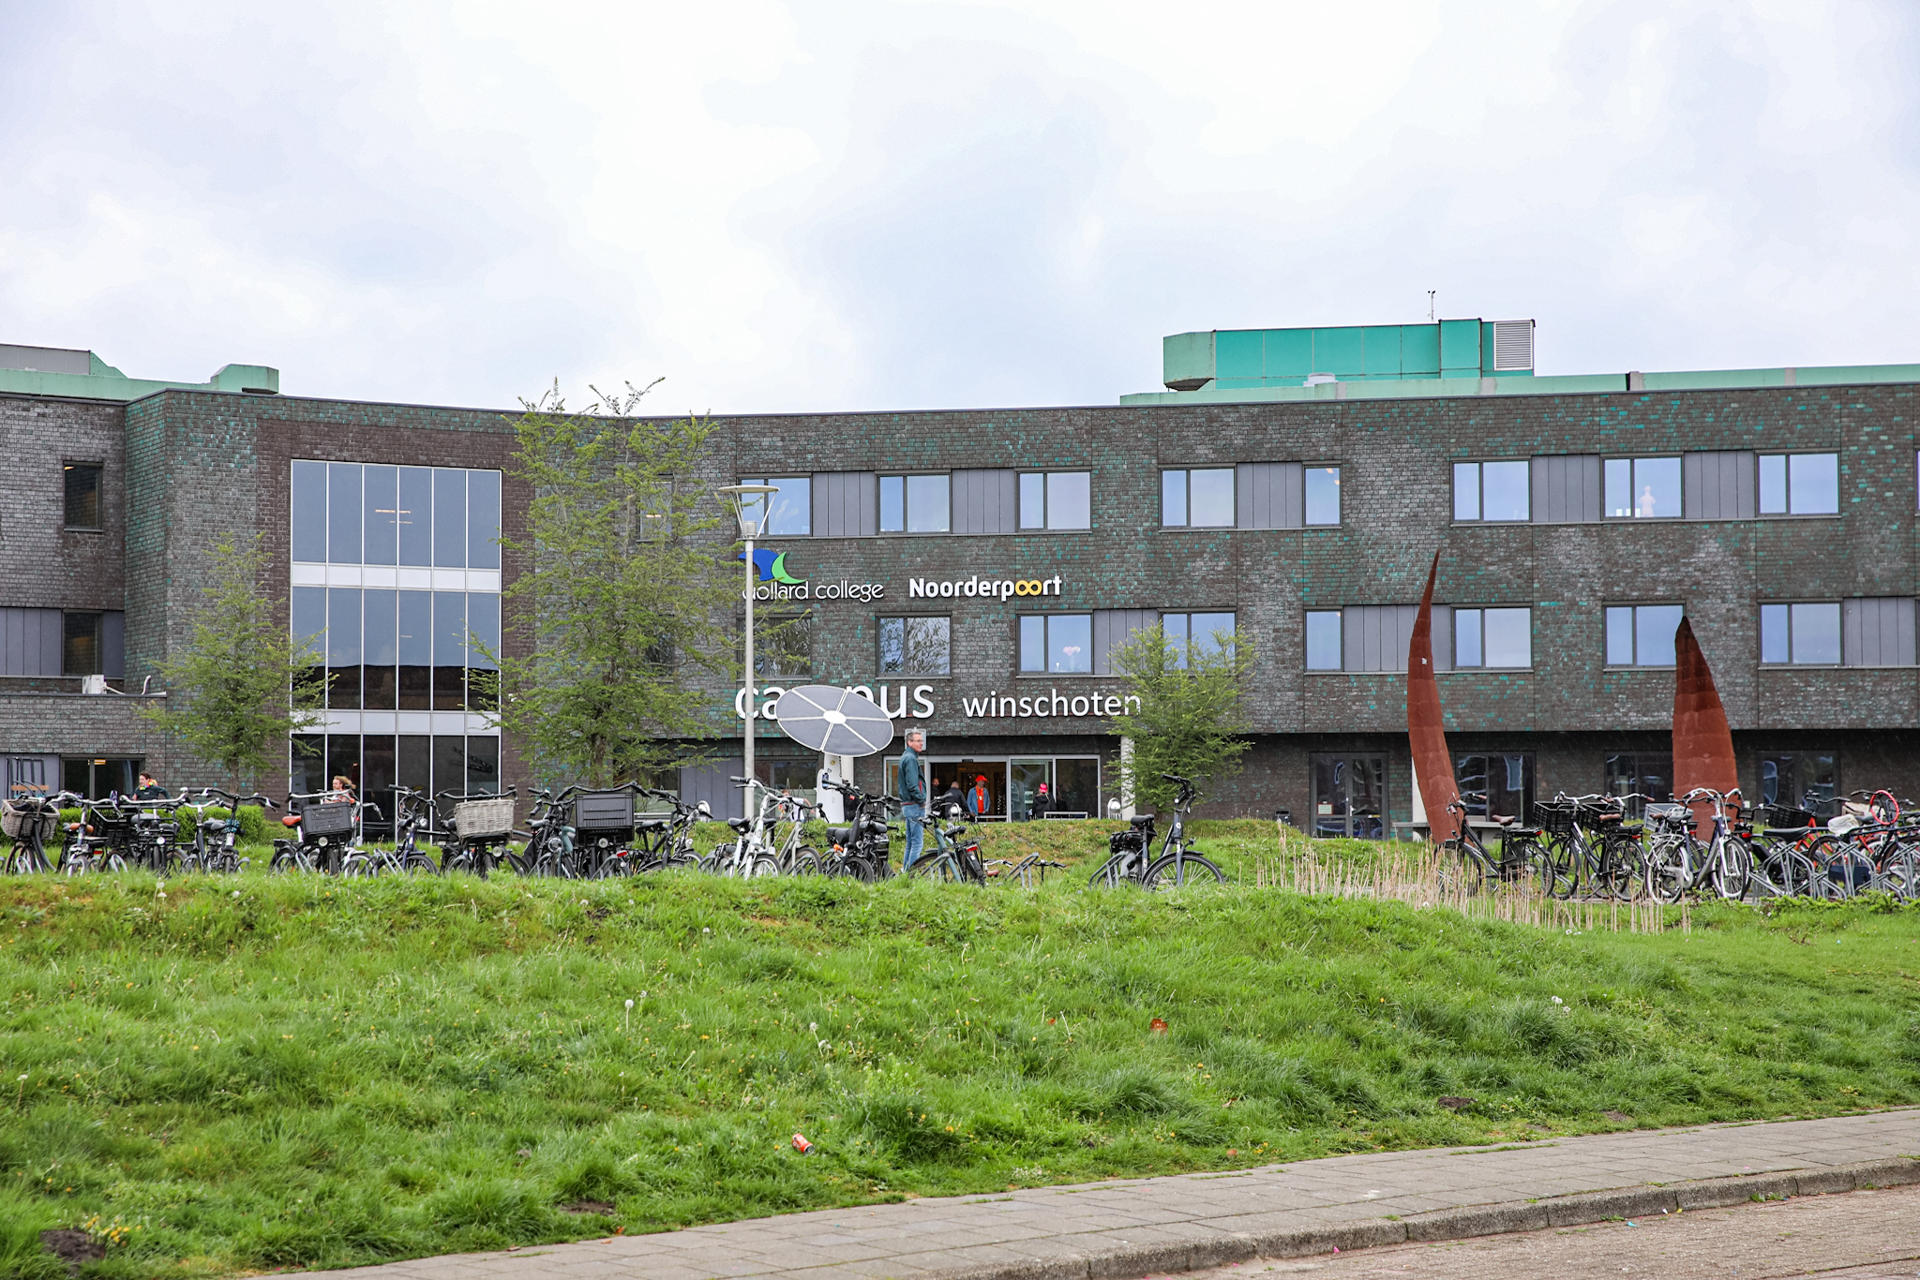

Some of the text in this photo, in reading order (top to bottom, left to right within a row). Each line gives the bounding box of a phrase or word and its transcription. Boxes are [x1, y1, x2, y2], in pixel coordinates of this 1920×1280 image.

[815, 580, 884, 603] college
[909, 575, 1063, 602] Noorderpoort
[735, 684, 1142, 720] caus winschoten
